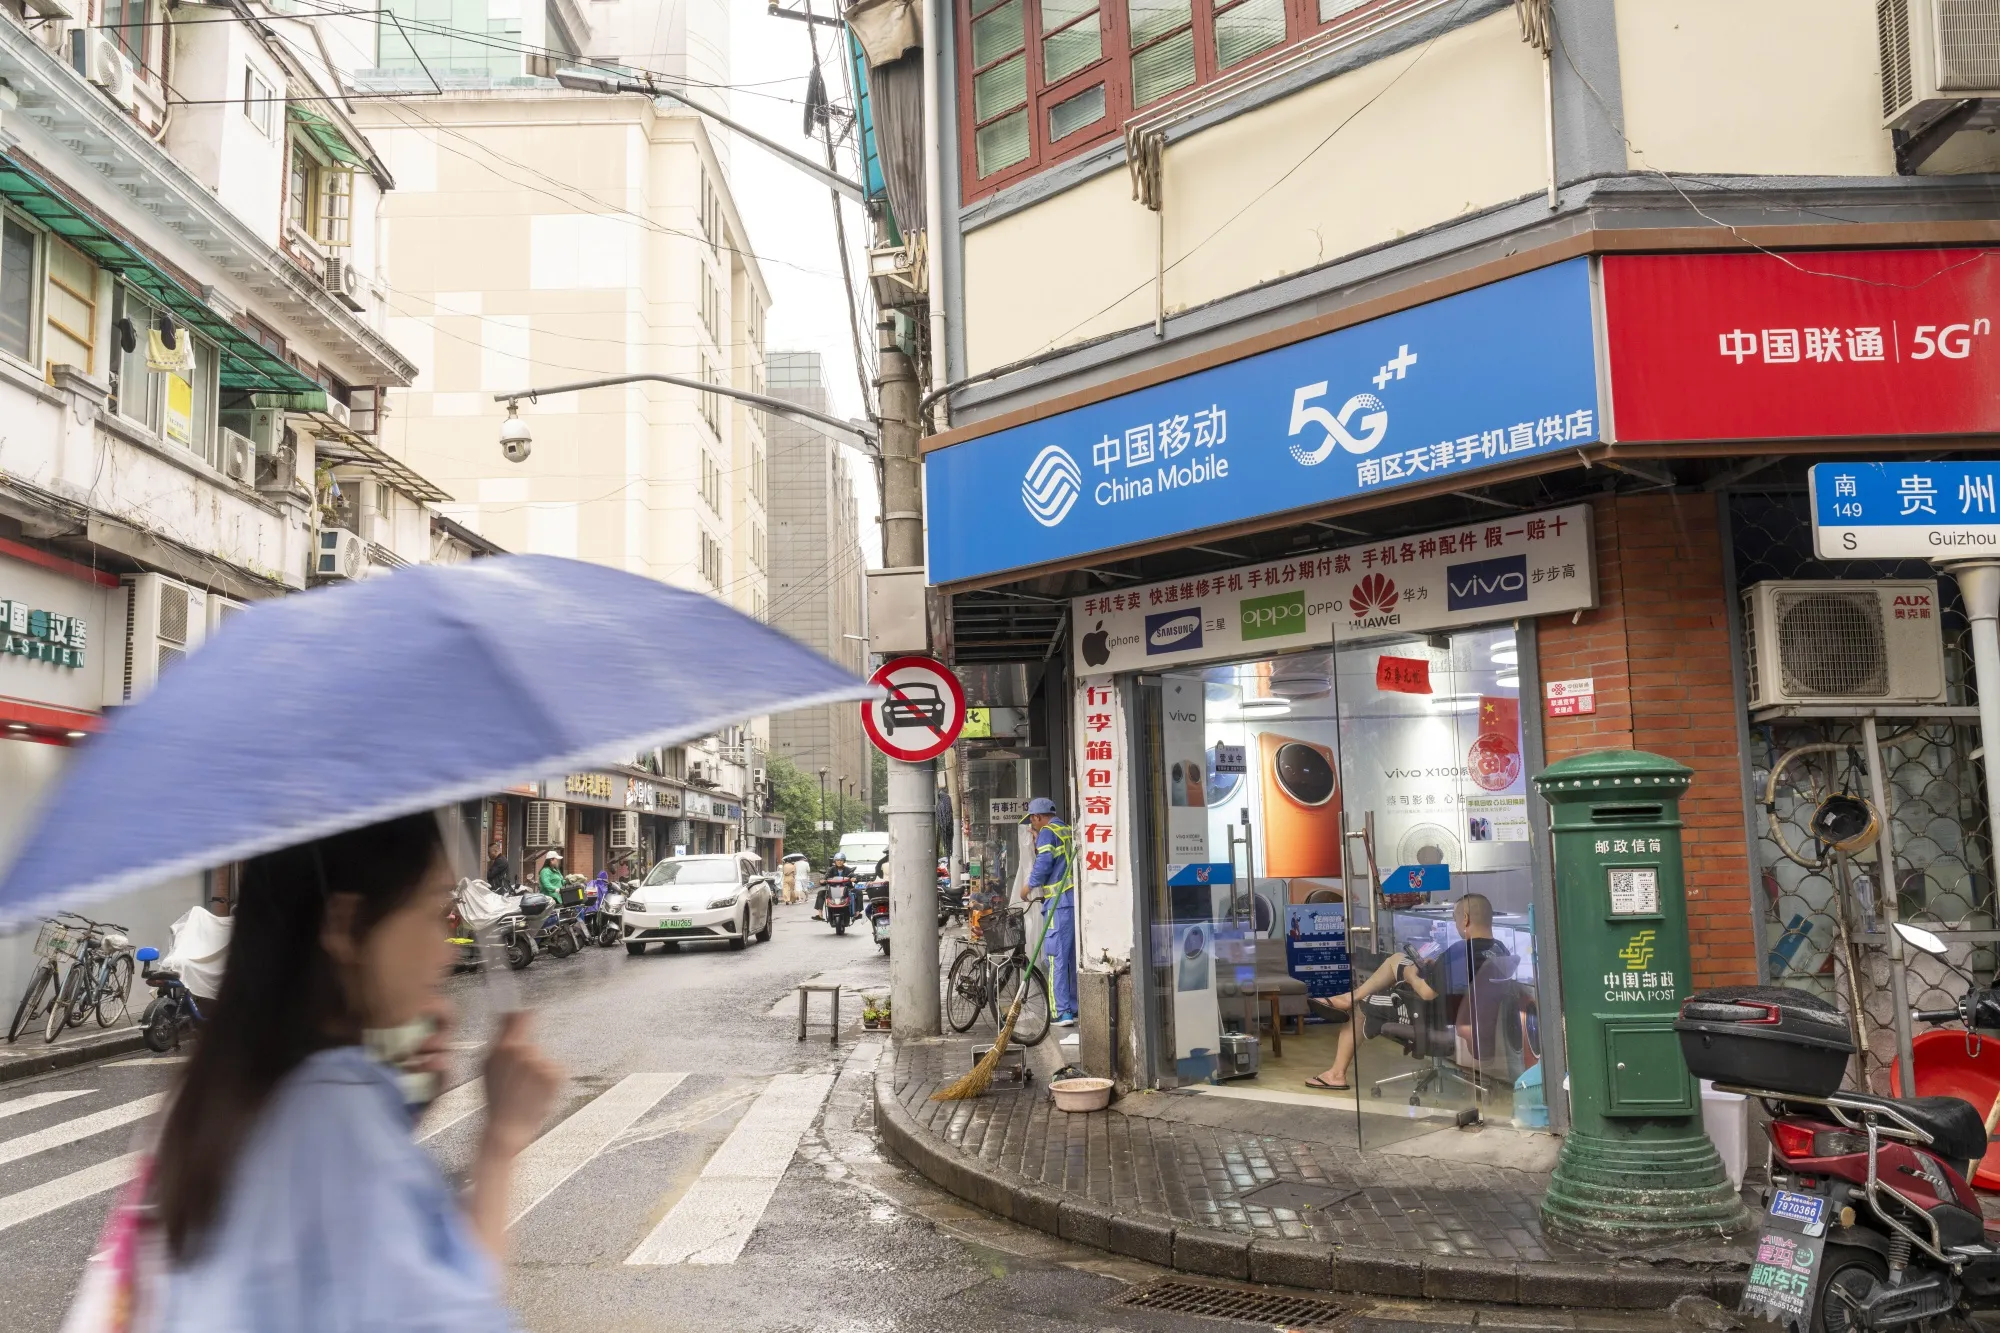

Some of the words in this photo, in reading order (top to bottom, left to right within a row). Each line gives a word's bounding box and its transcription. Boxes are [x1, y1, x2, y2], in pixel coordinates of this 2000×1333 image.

[1719, 327, 1885, 364] 中国联通
[1092, 403, 1228, 475] 中国移动
[1356, 408, 1593, 488] 南区天津手机直供店
[1095, 470, 1154, 506] China
[1157, 453, 1229, 492] Mobile
[1834, 473, 1857, 497] 南
[1897, 474, 1996, 515] 贵州
[1832, 503, 1862, 518] 149
[1842, 532, 1857, 551] S
[1928, 531, 1997, 546] Guizhou
[1084, 591, 1141, 617] 手机专卖
[1149, 573, 1243, 606] 快速维修手机
[1247, 553, 1351, 589] 手机分期付款
[1362, 530, 1477, 569] 手机各种配件
[1484, 515, 1568, 548] 假一赔十
[1531, 563, 1576, 584] 步步高
[1403, 586, 1428, 602] 华为
[1893, 596, 1930, 606] AUX
[1307, 600, 1343, 616] OPPO
[1895, 609, 1930, 619] 奥克斯
[50, 612, 87, 649] 汉堡
[1156, 622, 1194, 639] SAMSUNG
[1205, 617, 1226, 632] 三星
[1348, 614, 1401, 631] HUAWEI
[1108, 633, 1140, 649] iphone
[5, 635, 84, 667] ASTIEN
[1169, 709, 1197, 723] vivo
[1085, 686, 1113, 872] 行李箱包寄存处
[1384, 768, 1421, 779] vivo
[1425, 766, 1469, 777] X100系
[1595, 838, 1661, 854] 邮政信筒
[1604, 971, 1675, 988] 中国邮政
[1604, 990, 1646, 1001] CHINA
[1648, 989, 1674, 1001] POST
[1777, 1200, 1817, 1217] 7970366
